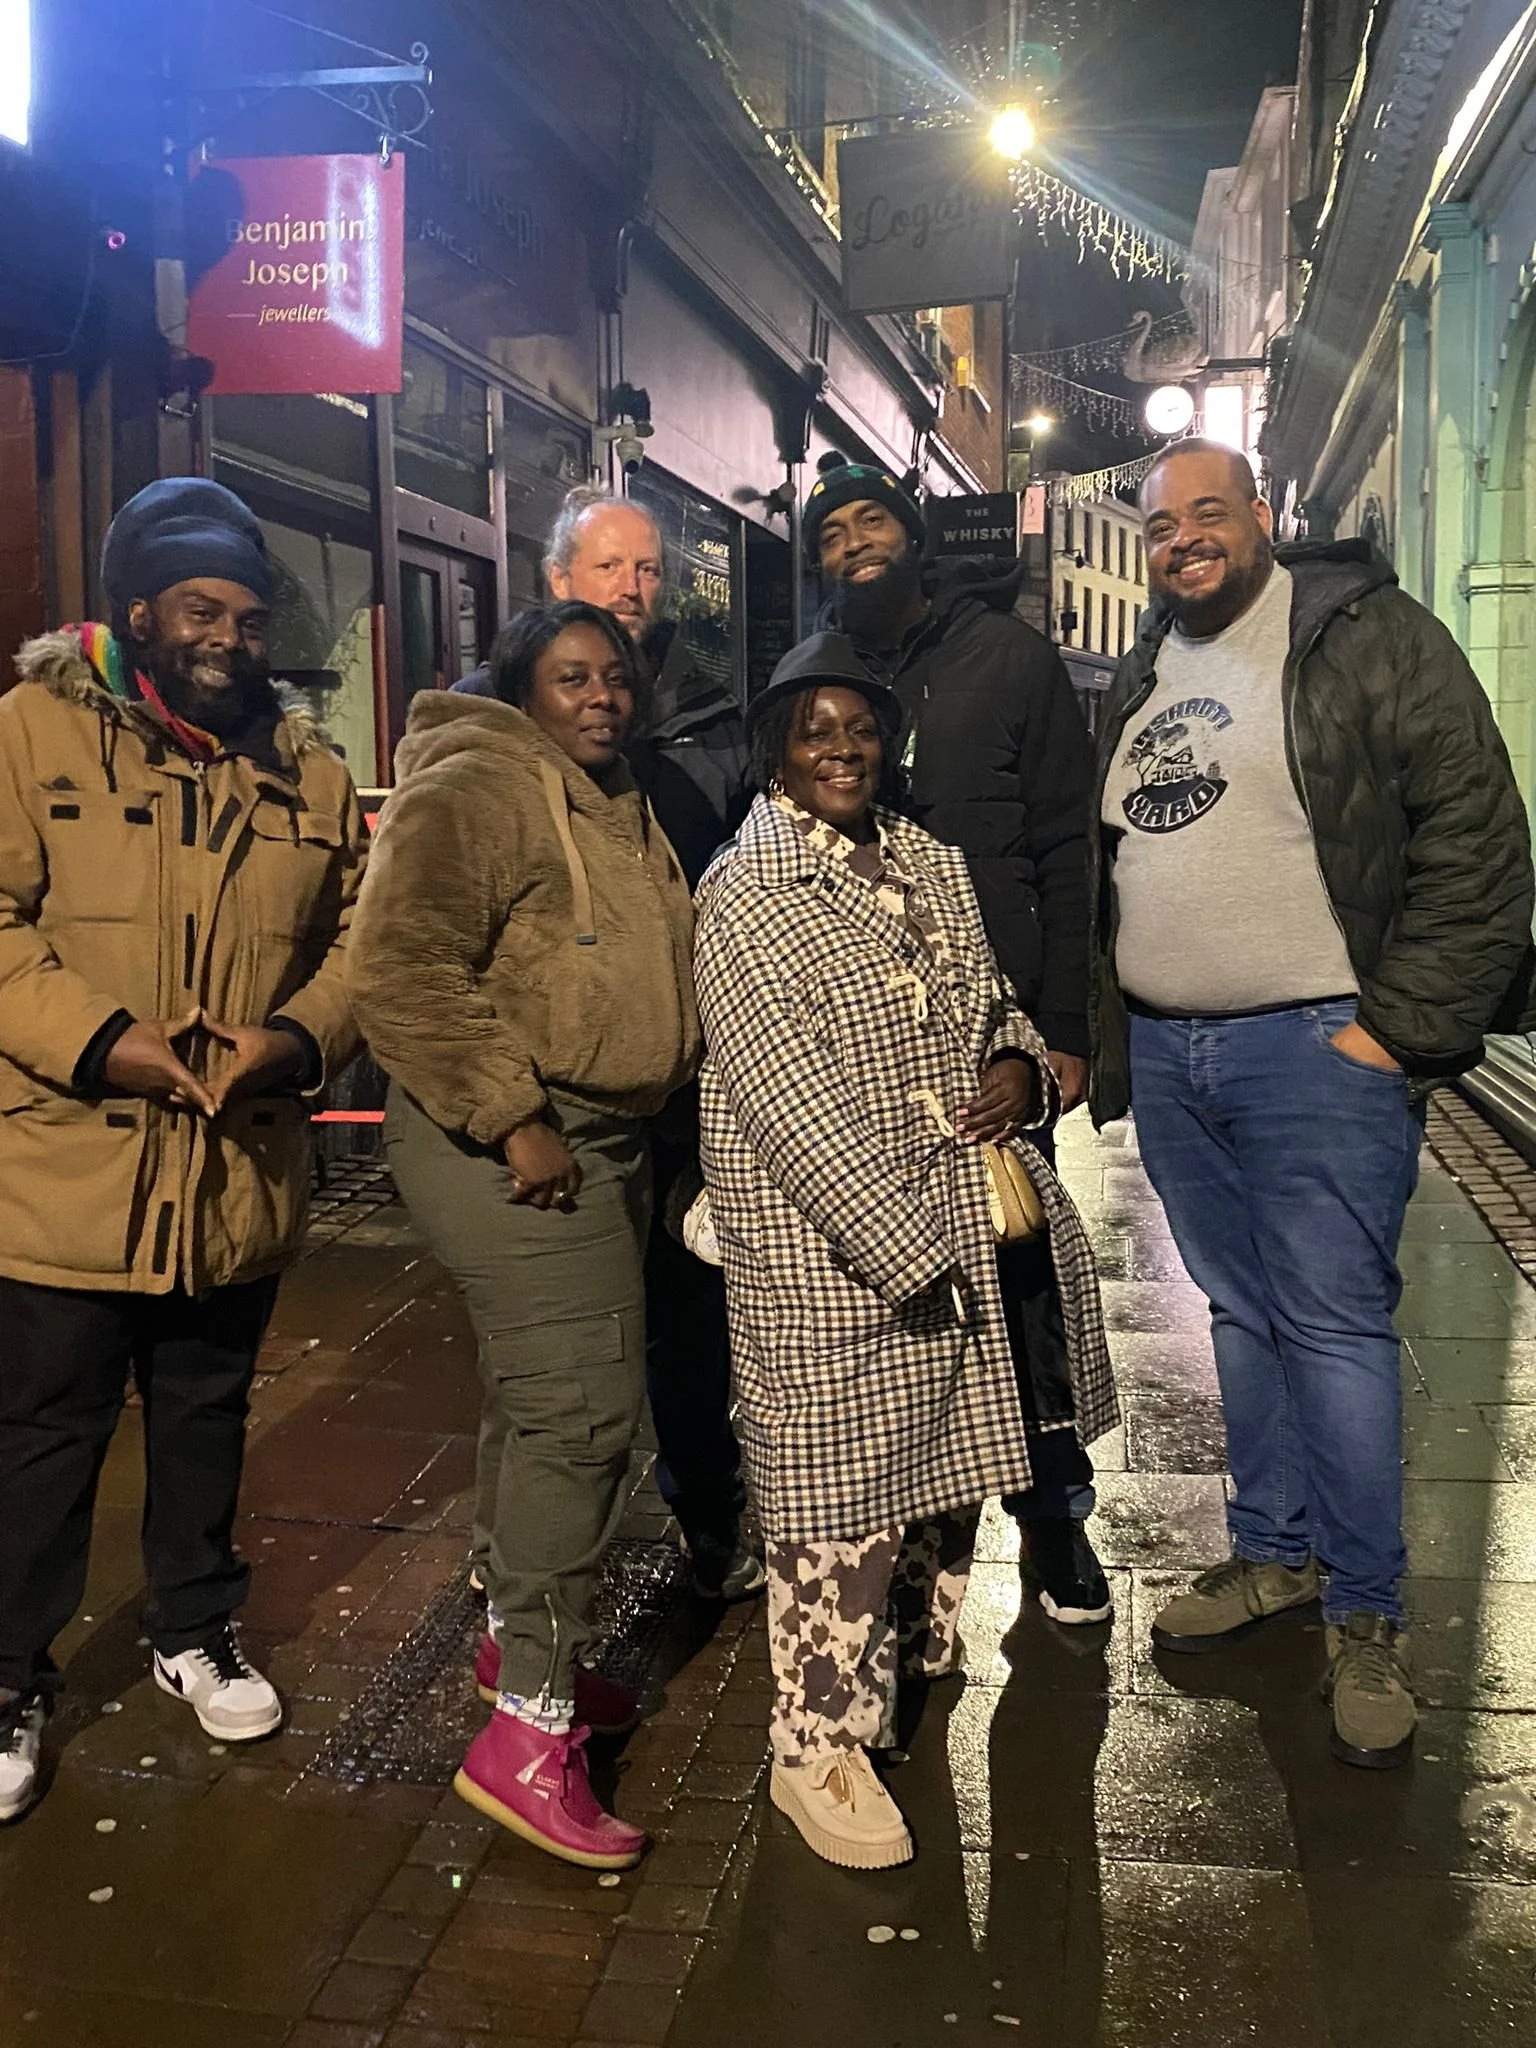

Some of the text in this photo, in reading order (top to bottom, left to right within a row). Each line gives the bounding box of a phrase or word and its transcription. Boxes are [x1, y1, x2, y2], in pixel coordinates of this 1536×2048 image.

[225, 212, 365, 251] Benjamin
[242, 260, 349, 292] Joseph
[258, 304, 332, 326] jewellers
[965, 507, 990, 518] THE
[943, 527, 1015, 543] WHISKY
[1129, 781, 1218, 828] YARD
